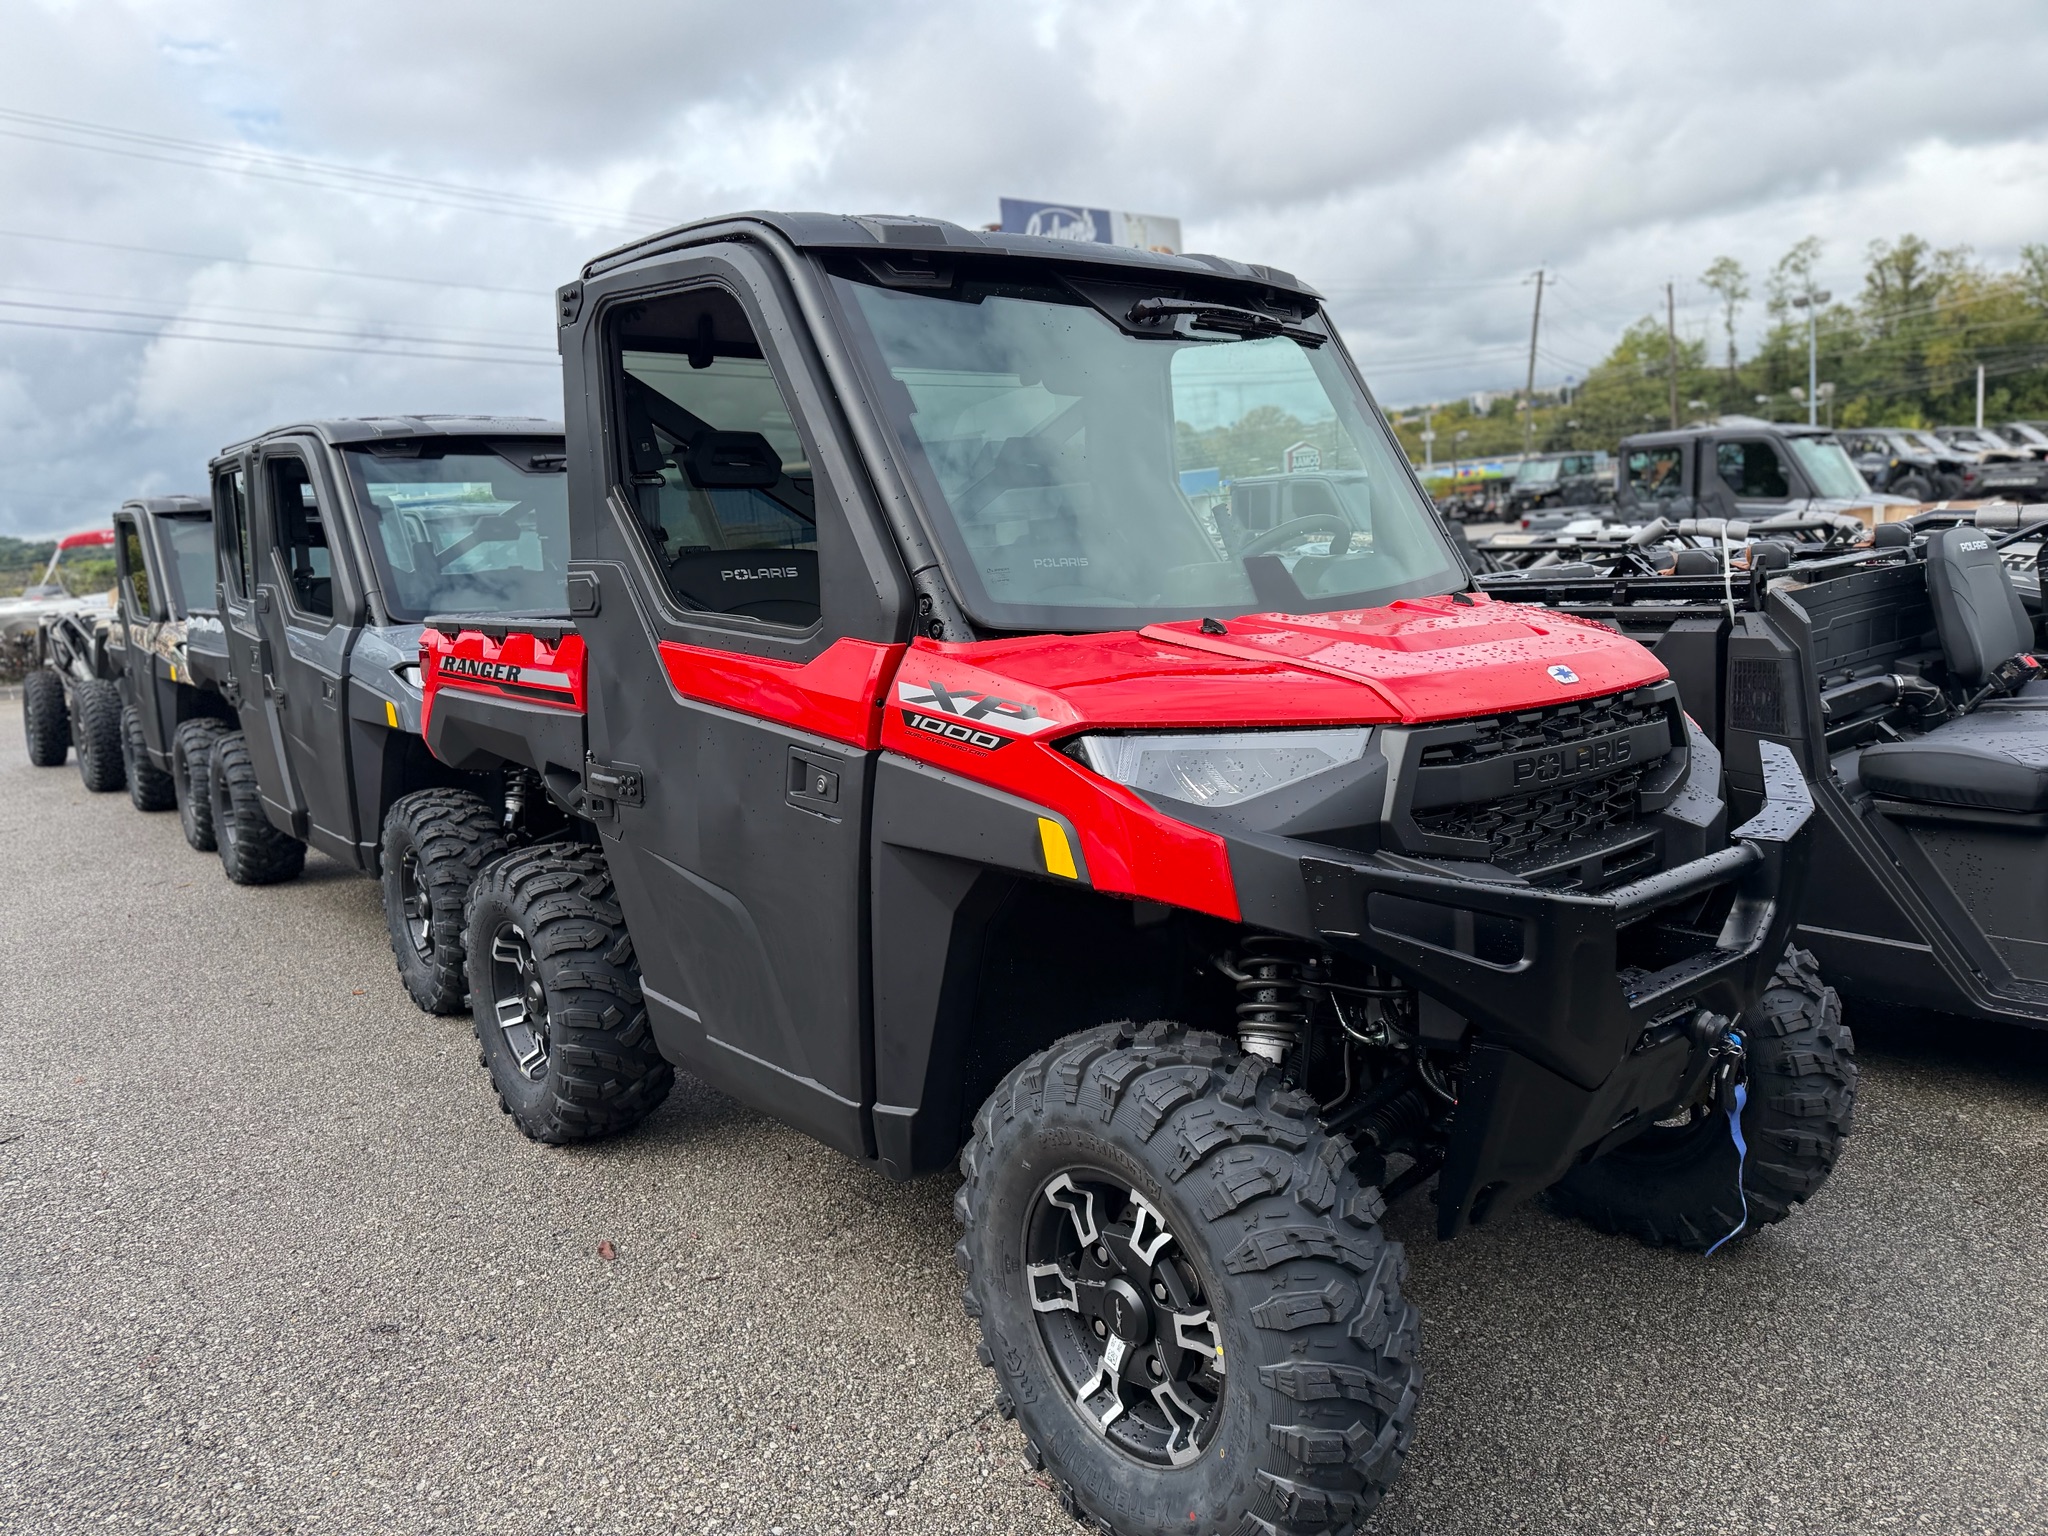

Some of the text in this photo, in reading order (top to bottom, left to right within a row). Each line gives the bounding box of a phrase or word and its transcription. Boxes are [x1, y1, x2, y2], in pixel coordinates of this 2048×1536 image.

[1960, 541, 1988, 552] POLARIS
[720, 567, 799, 581] POLARIS
[1033, 557, 1089, 568] POLARIS
[442, 655, 521, 682] RANGER
[903, 680, 1039, 720] XP
[904, 730, 988, 757] DUAL OVERHEAD CAM
[910, 714, 1000, 749] 1000
[1513, 735, 1631, 787] POLARIS
